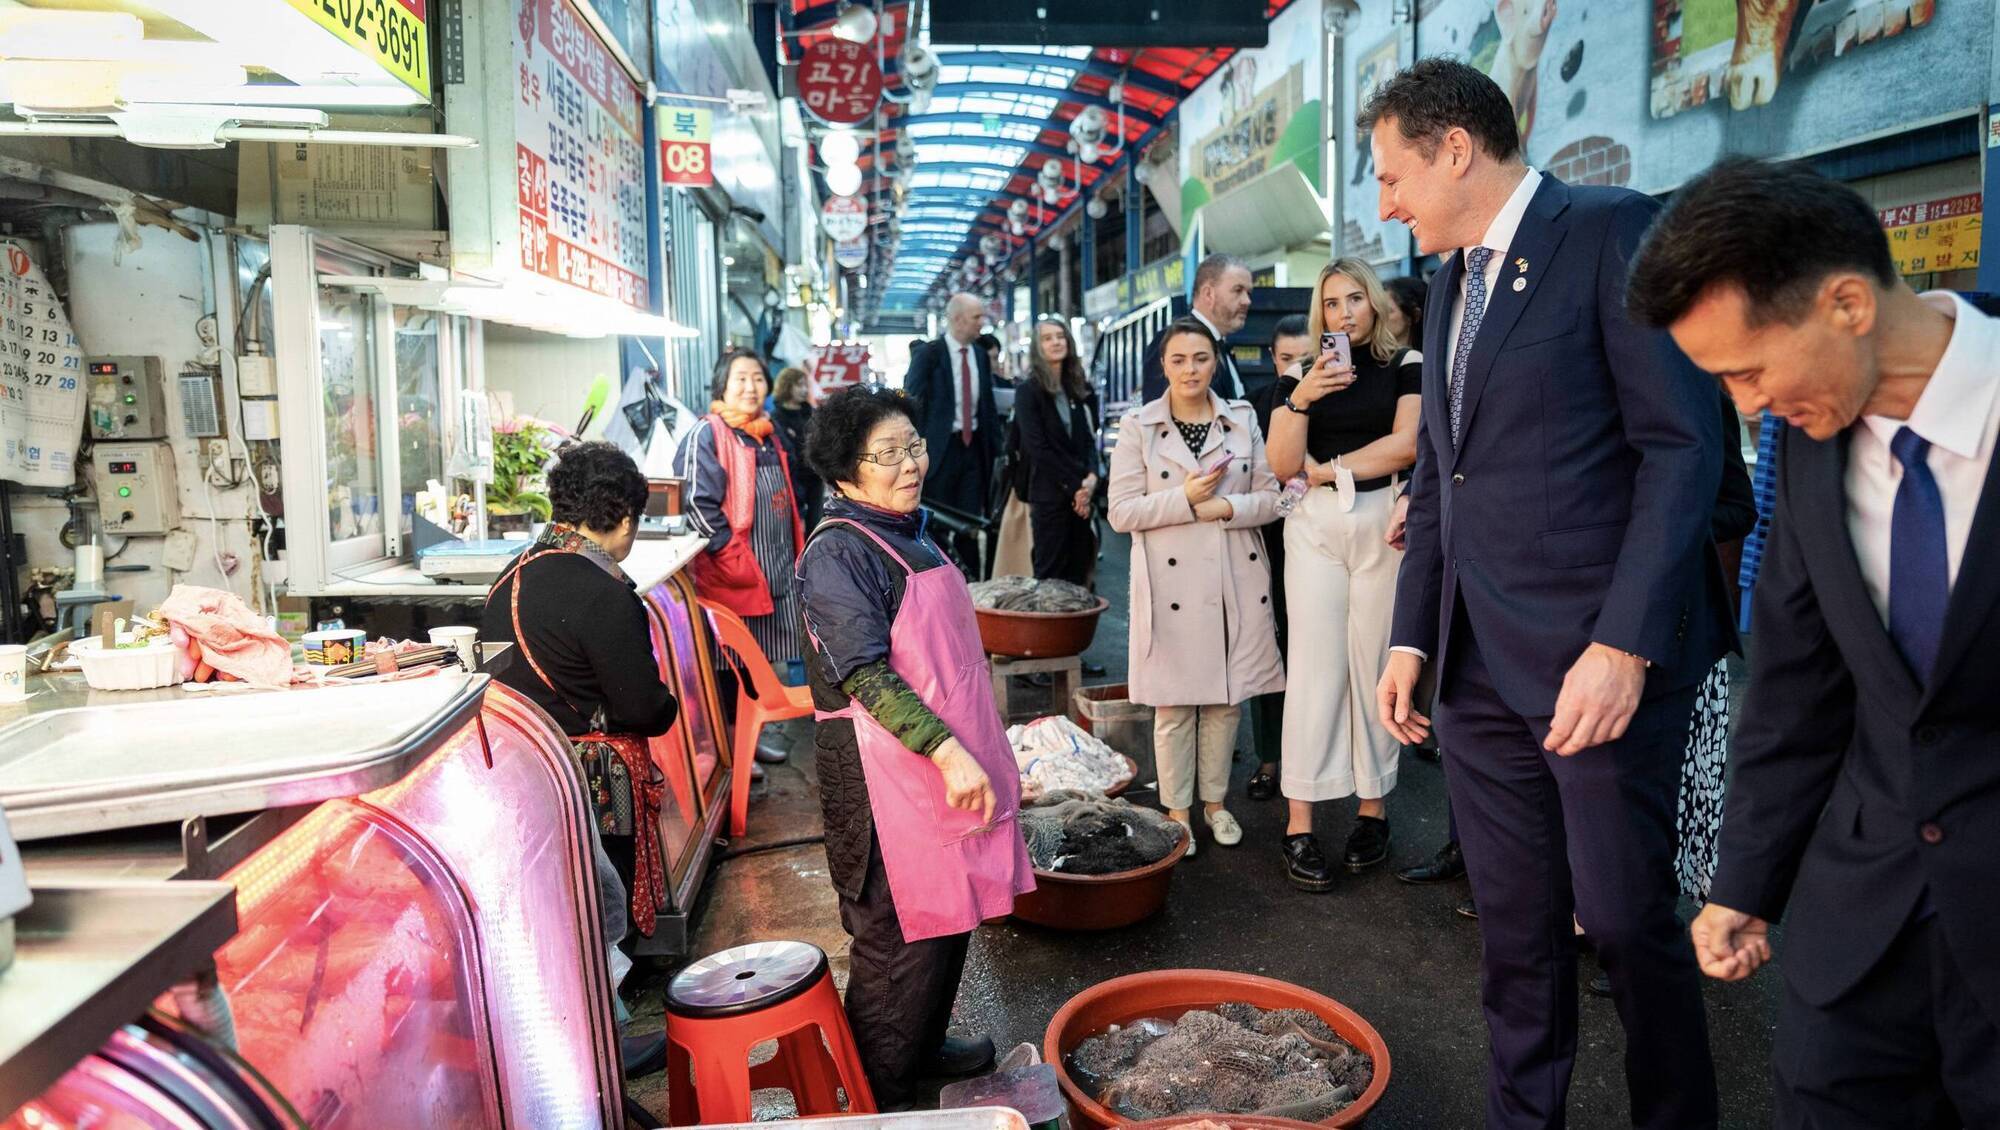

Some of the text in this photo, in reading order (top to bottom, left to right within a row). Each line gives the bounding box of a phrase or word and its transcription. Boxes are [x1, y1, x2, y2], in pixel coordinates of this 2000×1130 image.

[314, 0, 420, 78] 02-3691
[806, 61, 873, 85] 고기
[520, 62, 542, 112] 한우
[807, 85, 873, 115] 마을
[673, 112, 697, 136] 북
[666, 145, 705, 174] 08
[1878, 204, 1928, 226] 부산물
[24, 302, 33, 315] 5
[48, 307, 56, 320] 6
[20, 324, 33, 339] 12
[42, 329, 58, 343] 13
[9, 341, 17, 355] 17
[38, 351, 55, 365] 20
[64, 356, 79, 368] 21
[3, 362, 13, 376] 23
[35, 373, 52, 386] 27
[59, 377, 76, 391] 28
